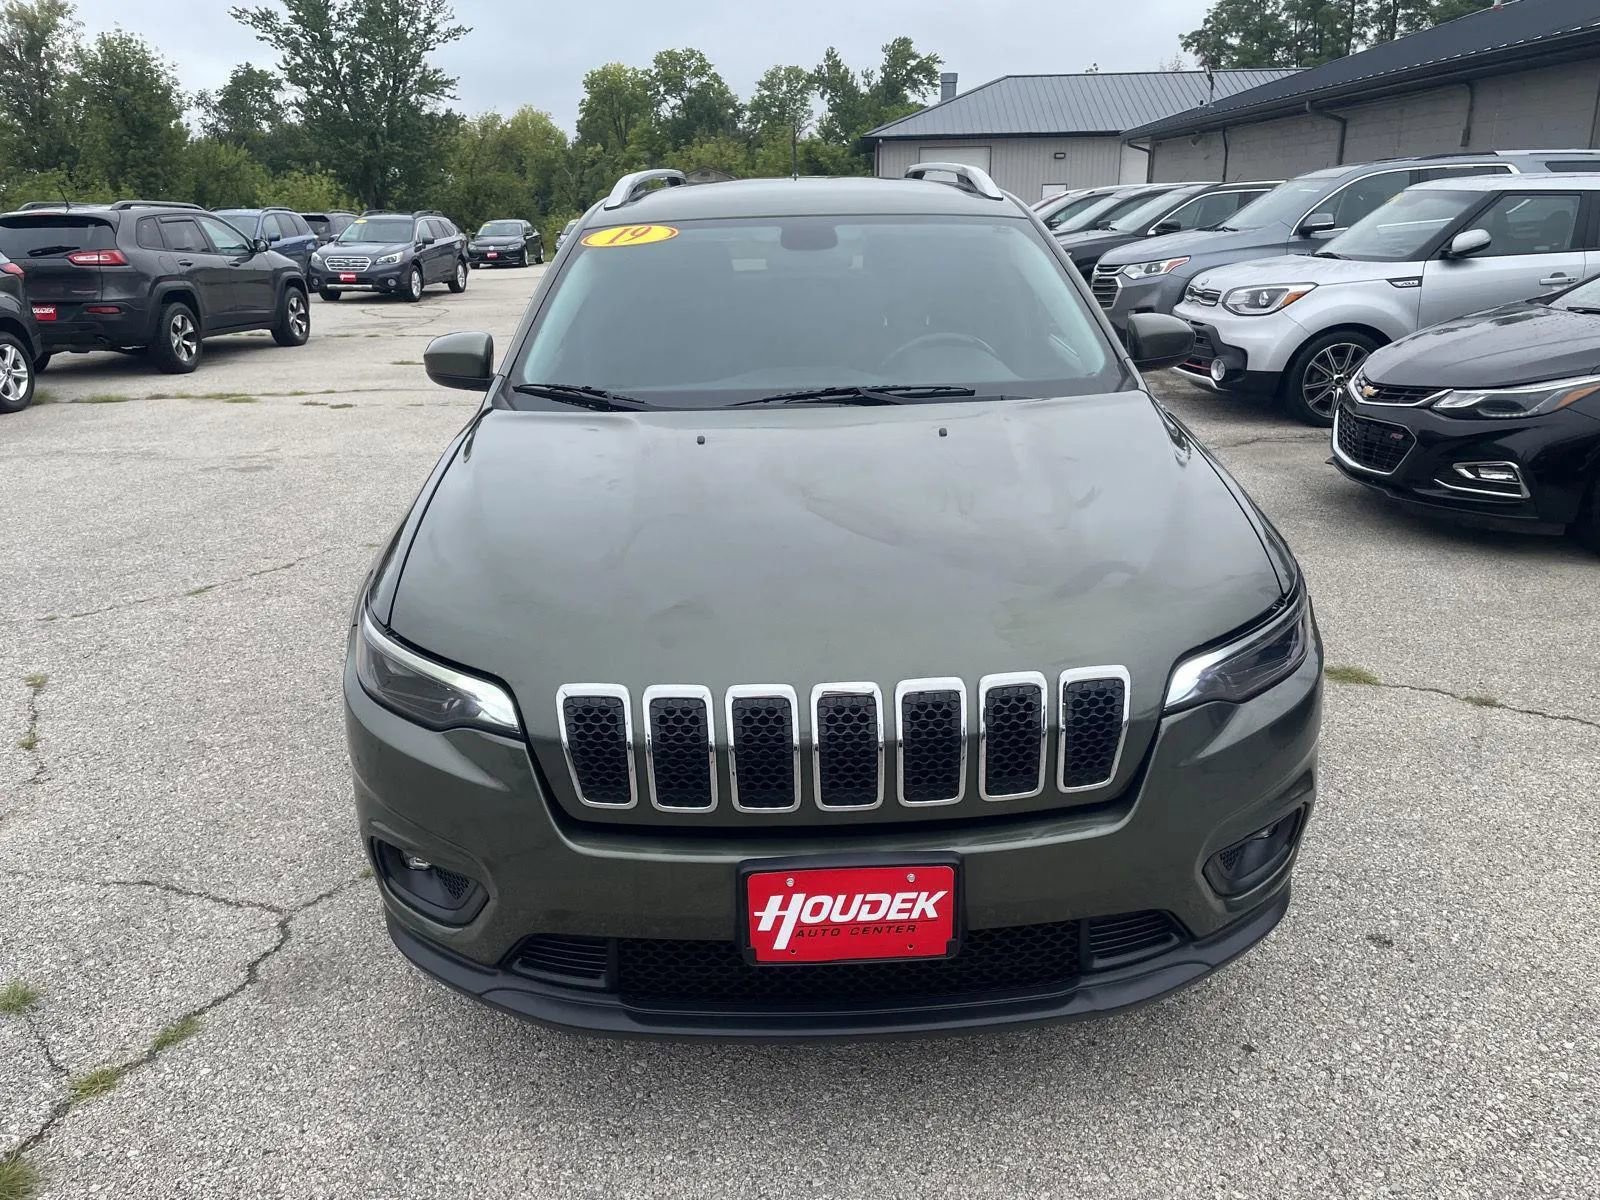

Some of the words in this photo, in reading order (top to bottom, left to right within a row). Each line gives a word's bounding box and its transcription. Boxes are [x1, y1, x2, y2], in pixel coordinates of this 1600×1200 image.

[605, 226, 652, 244] 19
[754, 891, 948, 949] HOUDEK
[795, 927, 840, 938] AUTO
[849, 925, 916, 936] CENTER
